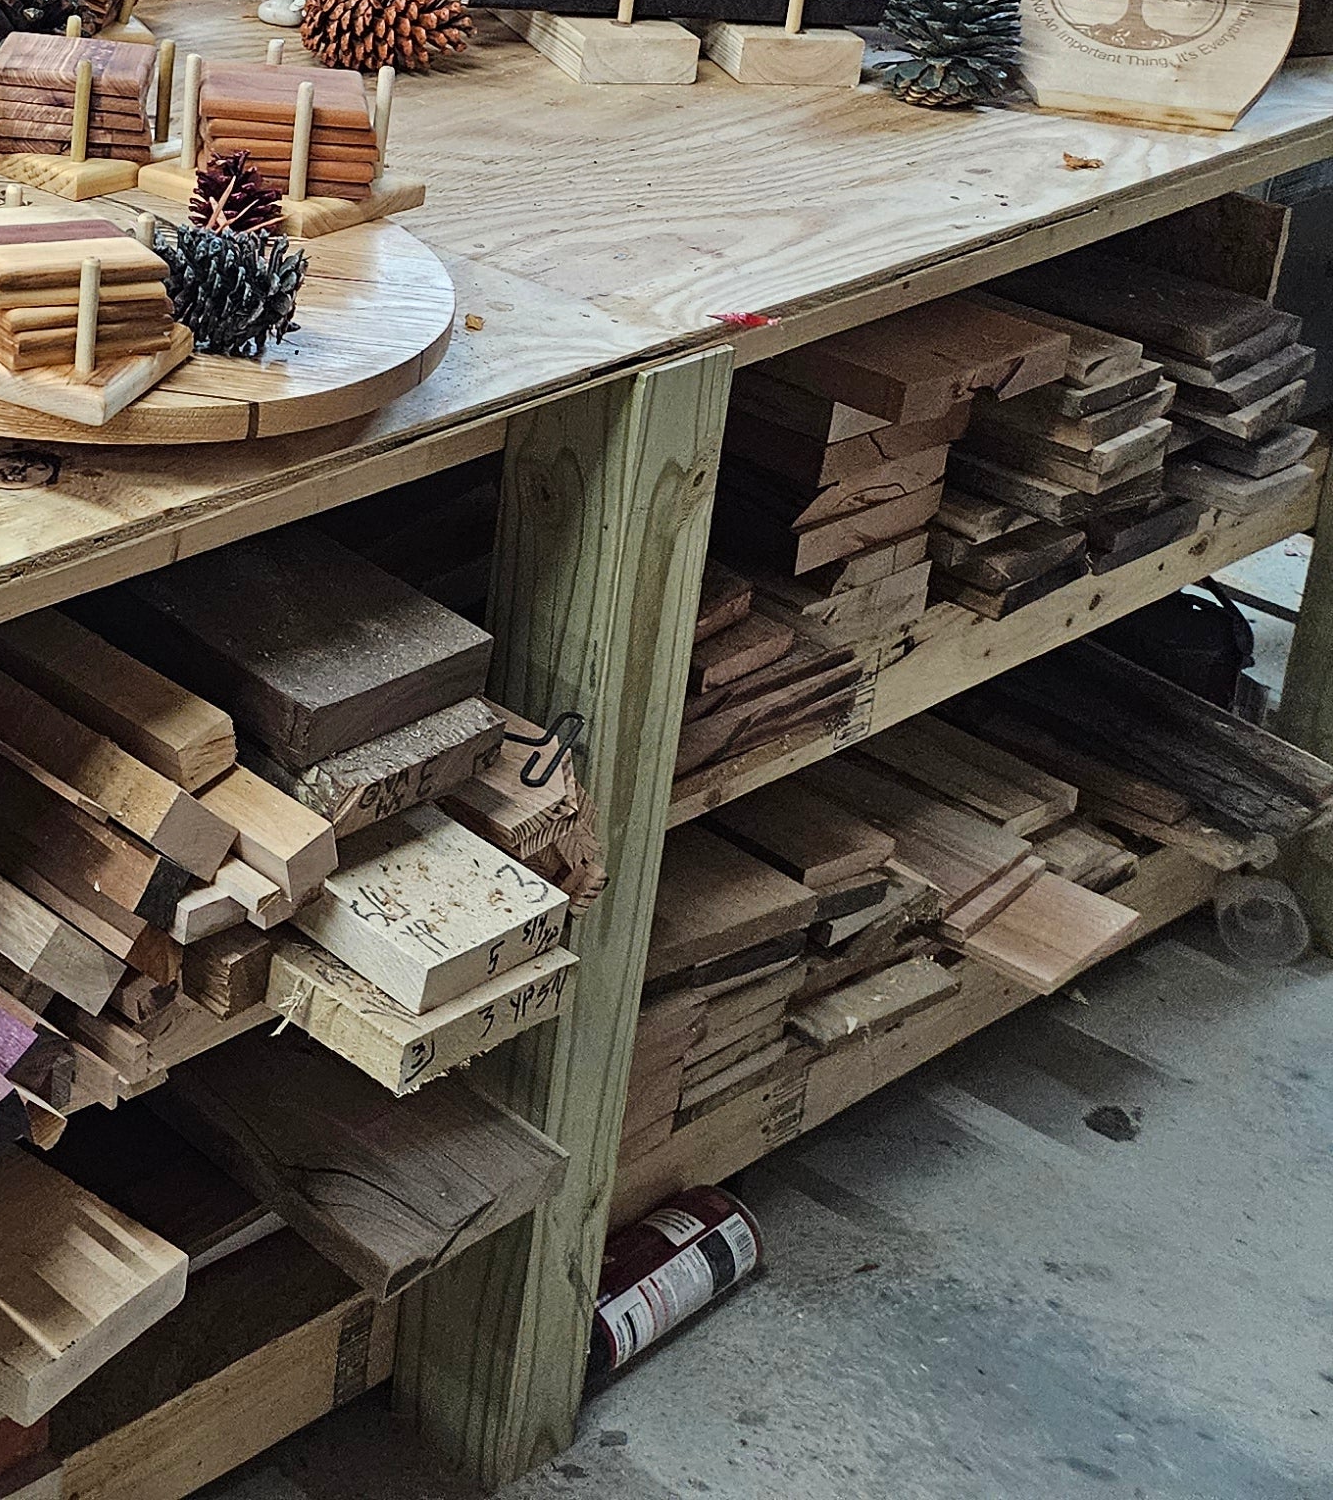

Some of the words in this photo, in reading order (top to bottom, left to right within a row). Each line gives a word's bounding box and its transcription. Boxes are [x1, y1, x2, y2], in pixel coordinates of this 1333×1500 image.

[1041, 16, 1059, 32] An
[1056, 30, 1122, 63] Important
[1176, 50, 1199, 63] It's
[478, 1005, 495, 1039] 3
